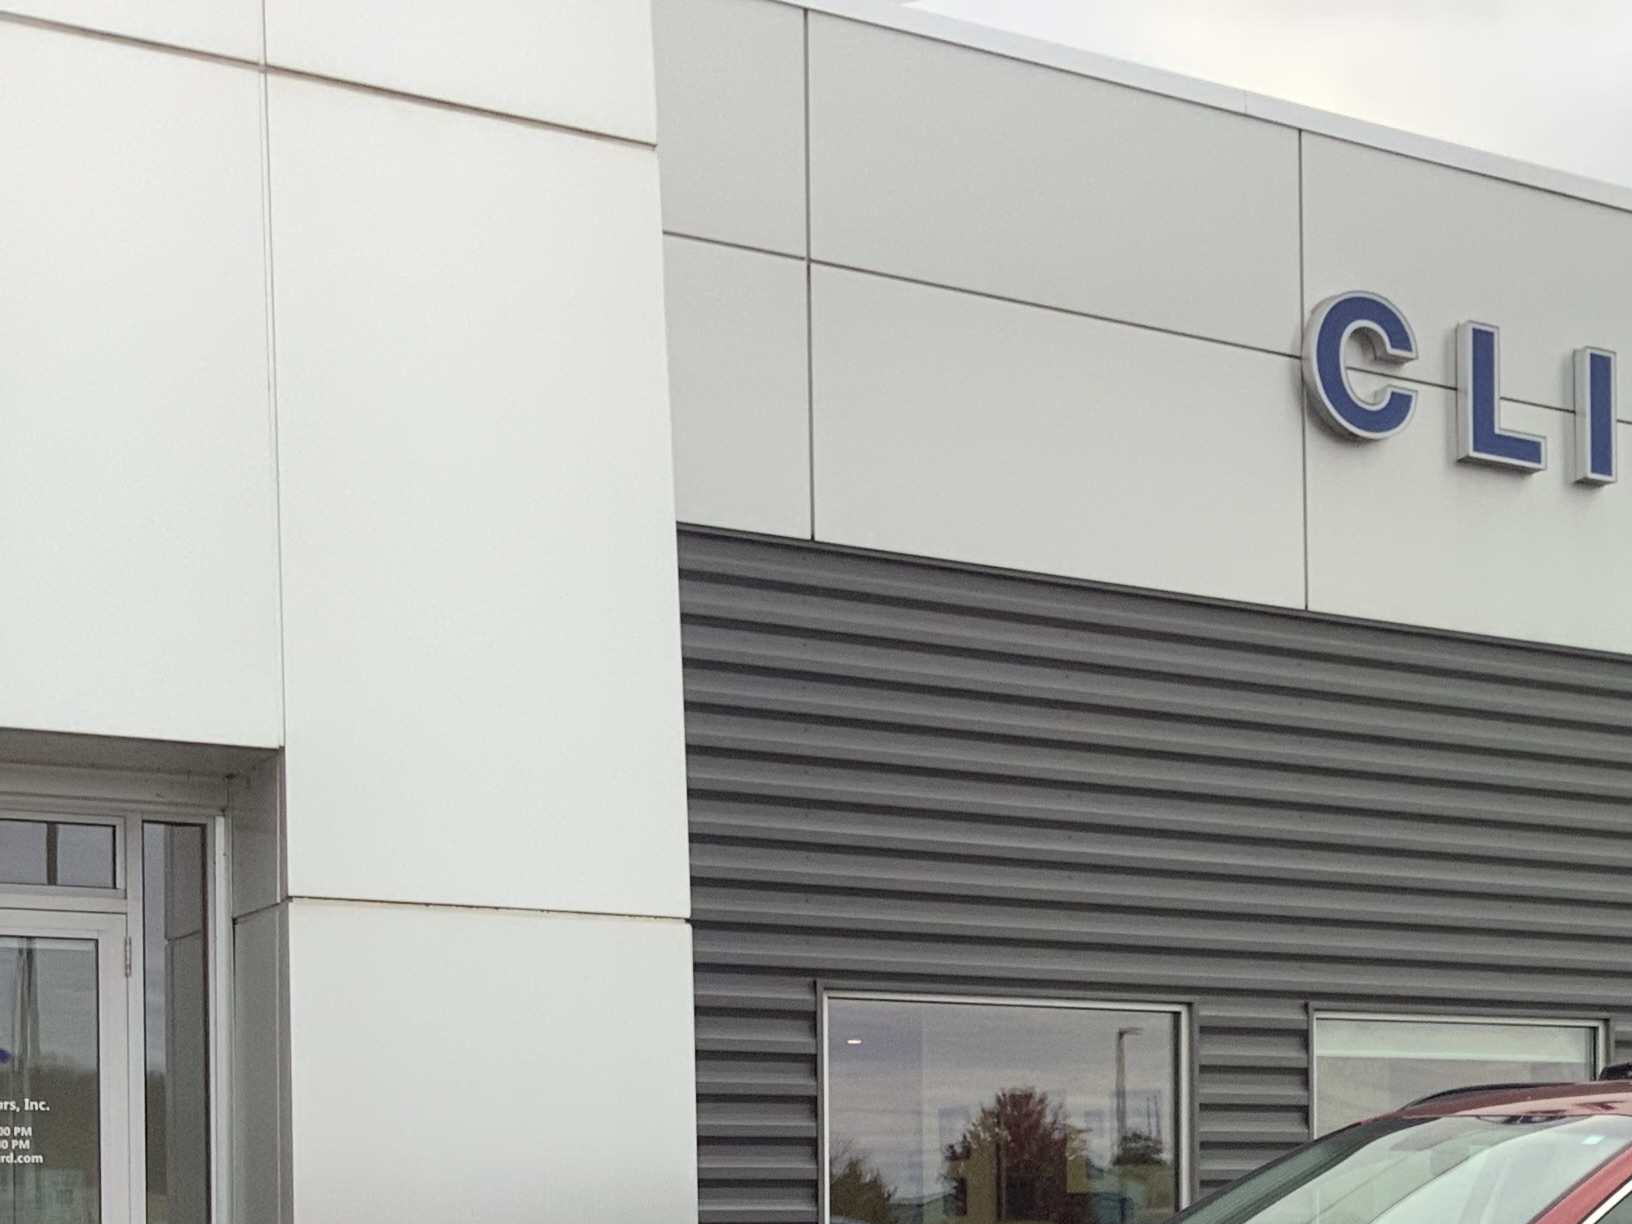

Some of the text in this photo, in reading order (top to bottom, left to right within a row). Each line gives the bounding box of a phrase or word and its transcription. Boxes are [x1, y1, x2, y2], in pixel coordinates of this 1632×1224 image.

[24, 1098, 51, 1111] Inc.
[14, 1126, 32, 1137] PM
[11, 1139, 30, 1149] PM
